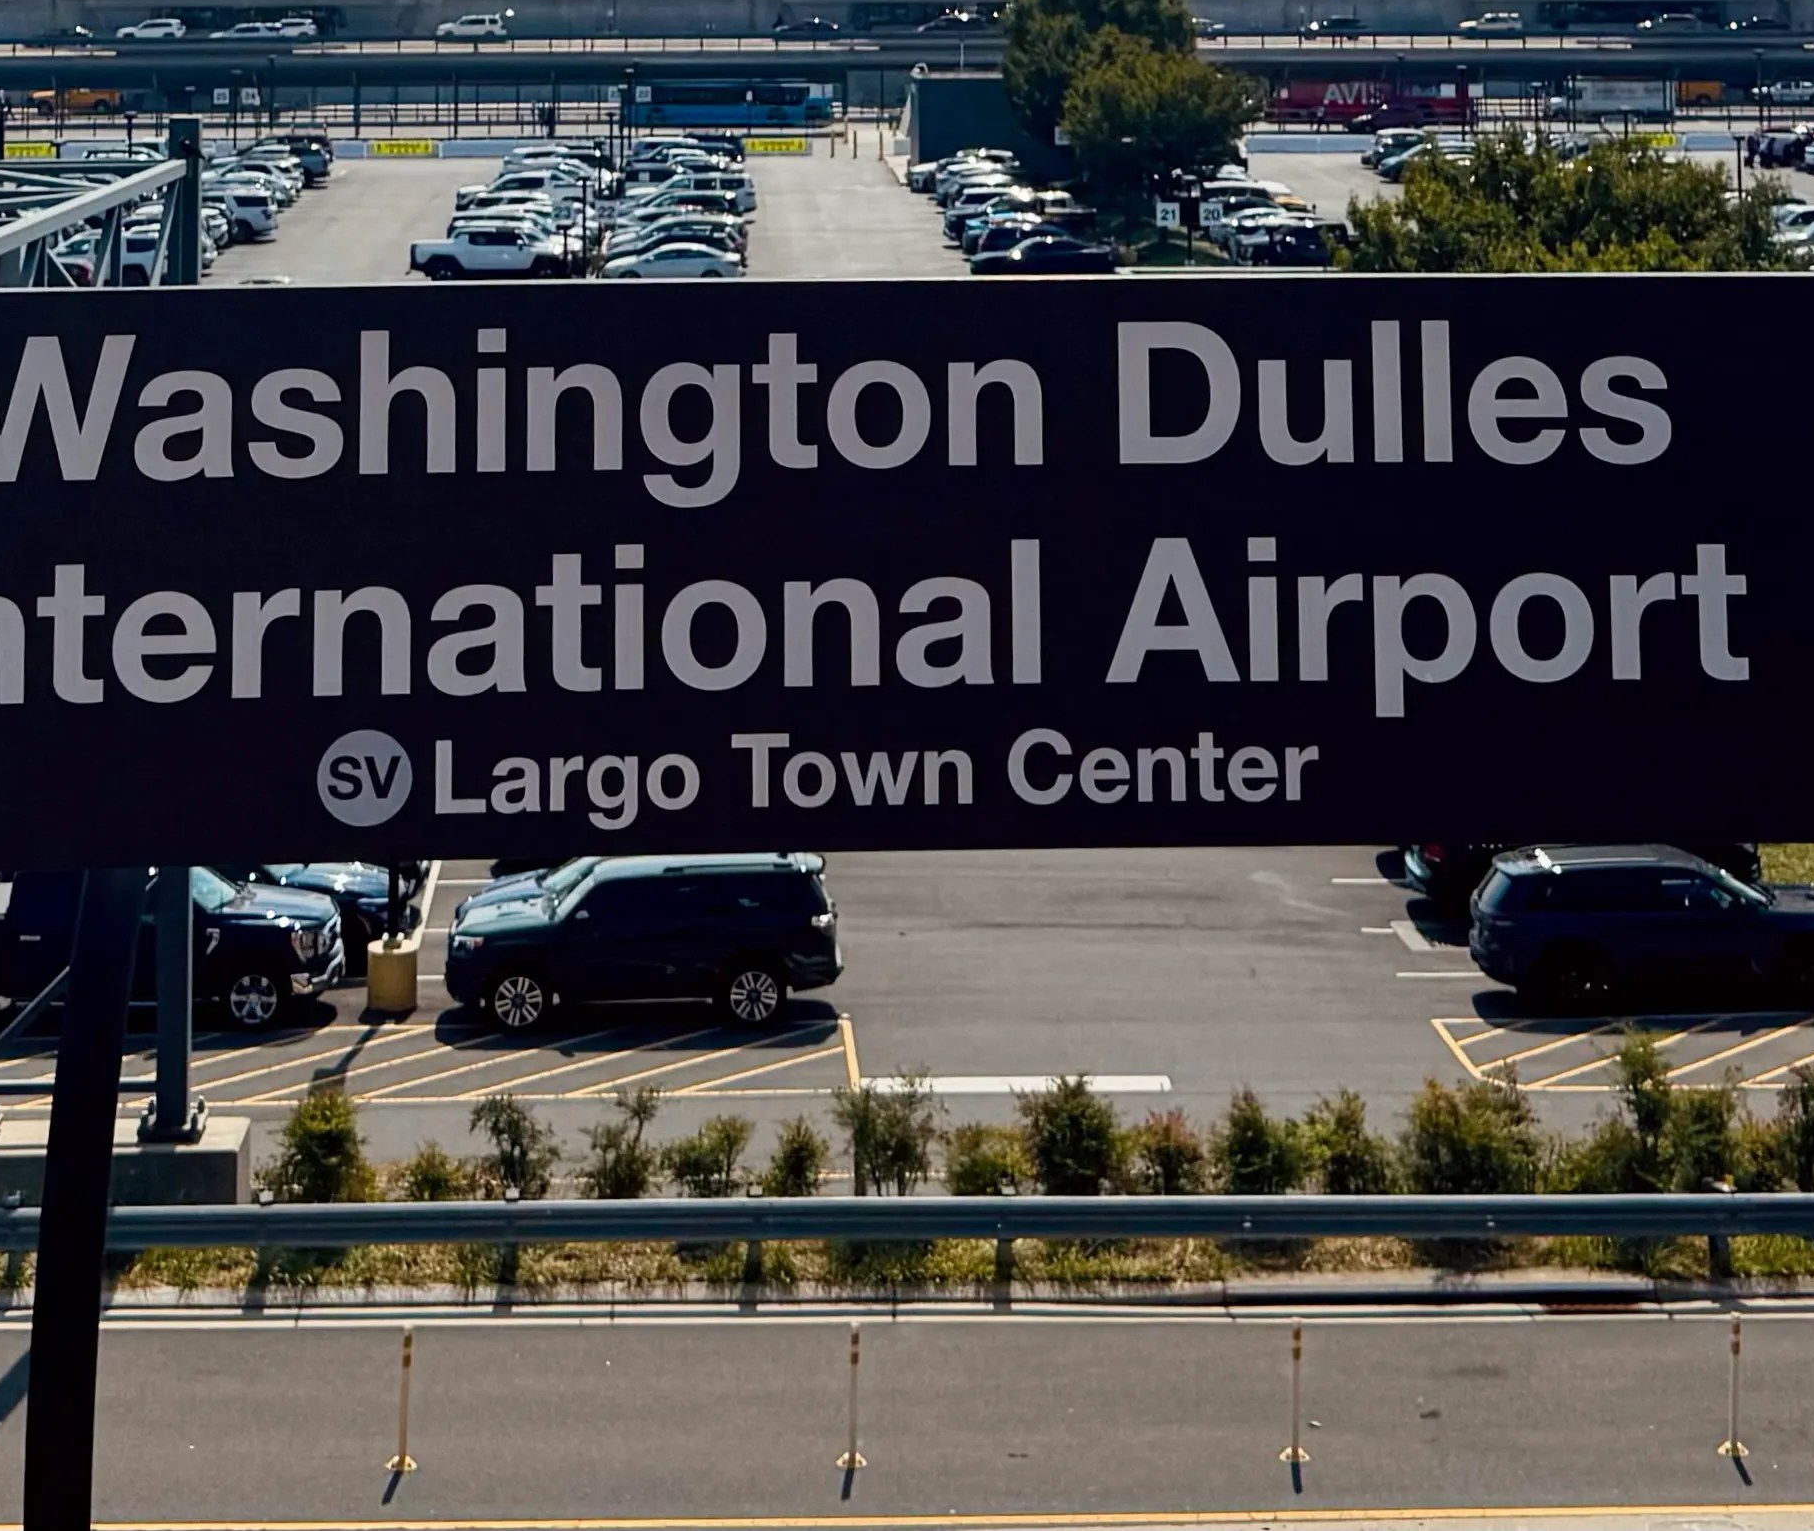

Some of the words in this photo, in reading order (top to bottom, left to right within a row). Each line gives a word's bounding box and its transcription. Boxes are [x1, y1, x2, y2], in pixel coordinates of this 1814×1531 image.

[598, 205, 615, 218] 22
[1160, 208, 1177, 221] 21
[1203, 208, 1220, 220] 20
[1118, 320, 1671, 465] Dulles
[1106, 537, 1749, 717] Airport
[328, 755, 401, 800] SV
[435, 740, 699, 829] Largo
[732, 733, 972, 807] Town
[1008, 729, 1318, 804] Center
